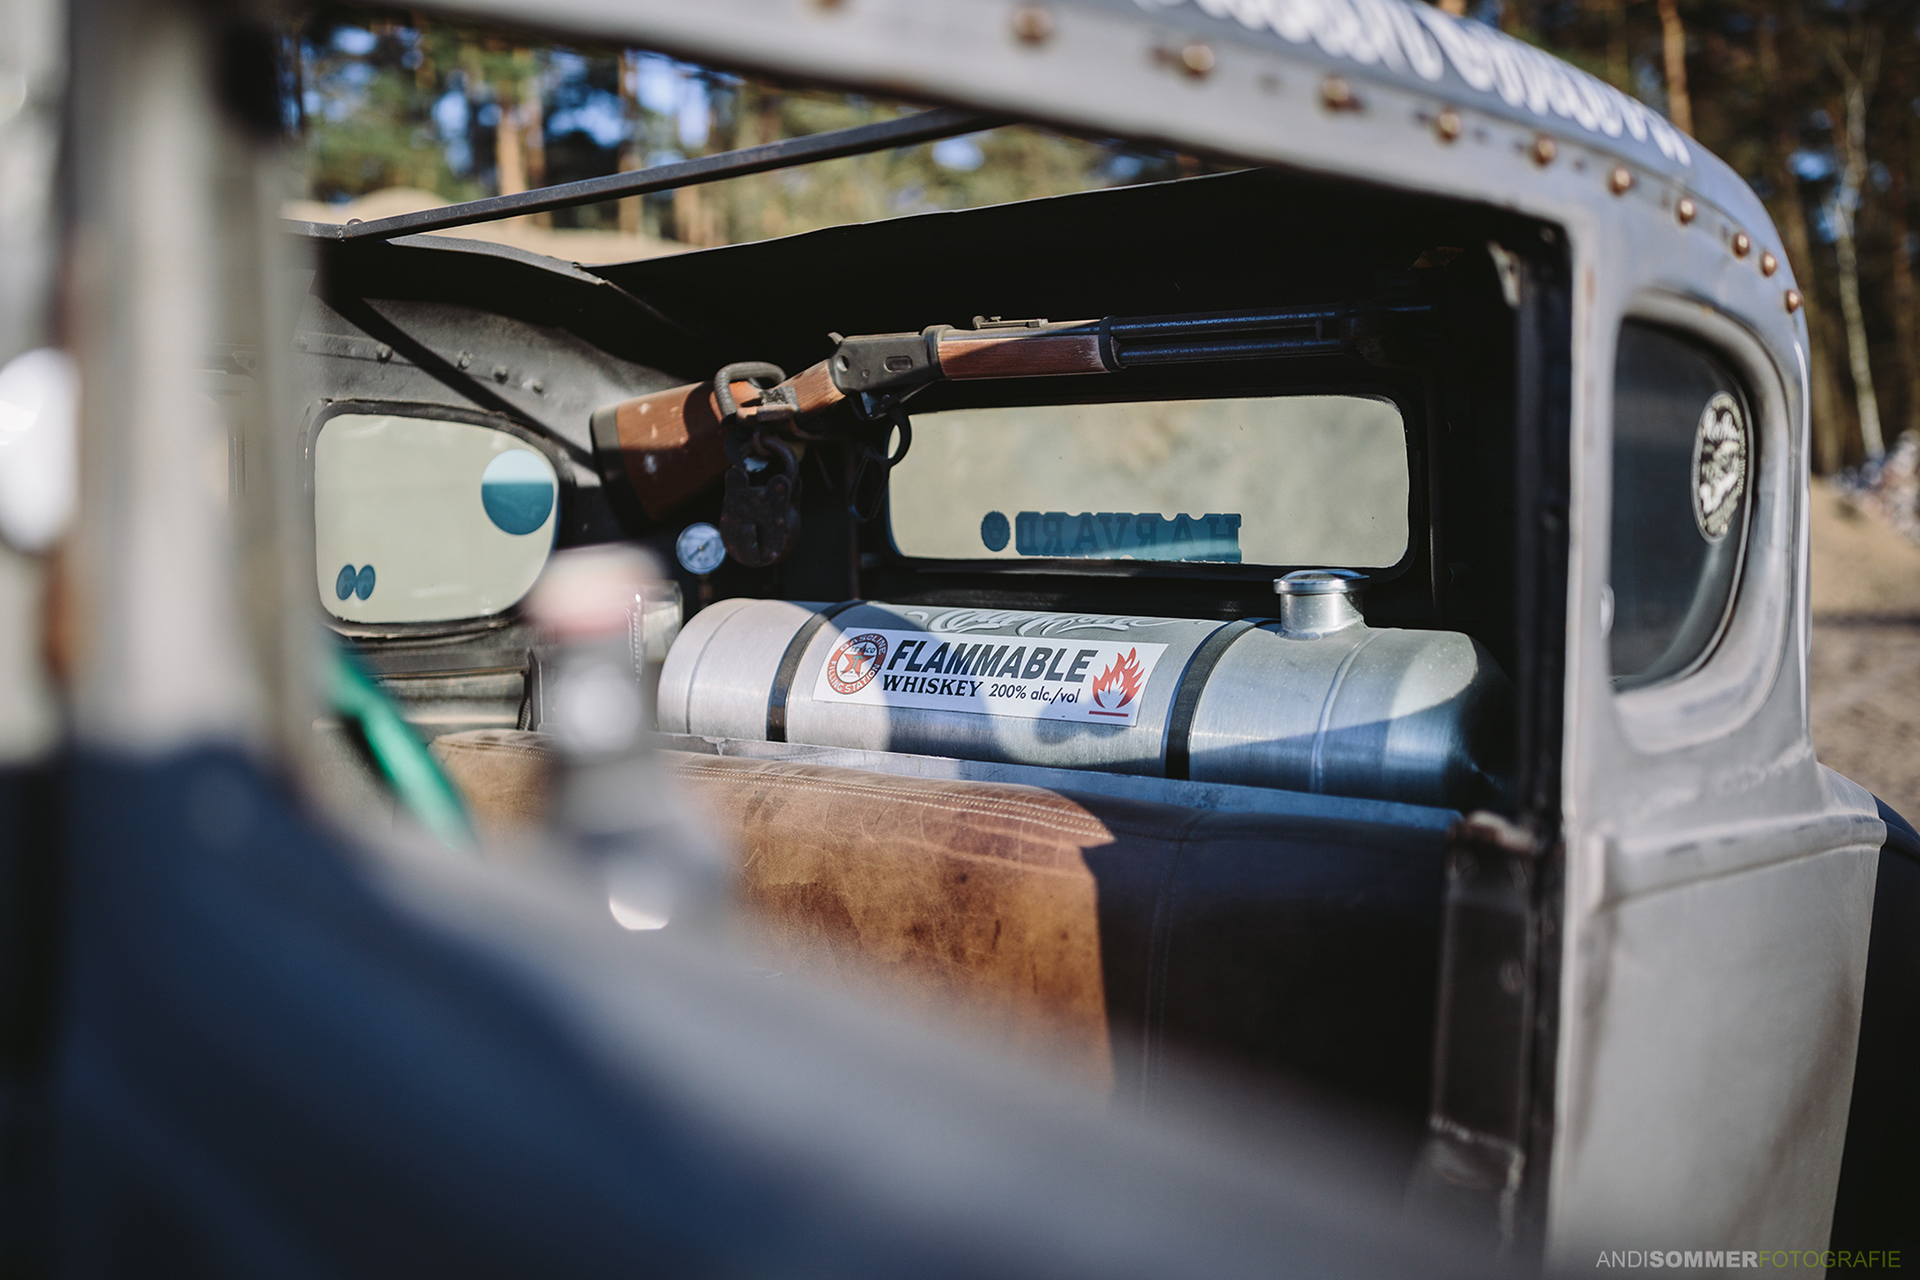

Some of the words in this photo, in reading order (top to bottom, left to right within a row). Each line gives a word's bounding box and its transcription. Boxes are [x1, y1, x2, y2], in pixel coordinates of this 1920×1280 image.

[840, 635, 887, 656] GASOLINE
[887, 639, 1099, 683] FLAMMABLE
[828, 660, 843, 691] FILLING
[844, 664, 881, 693] STATION
[882, 674, 984, 698] WHISKEY
[988, 682, 1027, 701] 200%
[1030, 685, 1081, 705] alc./vol
